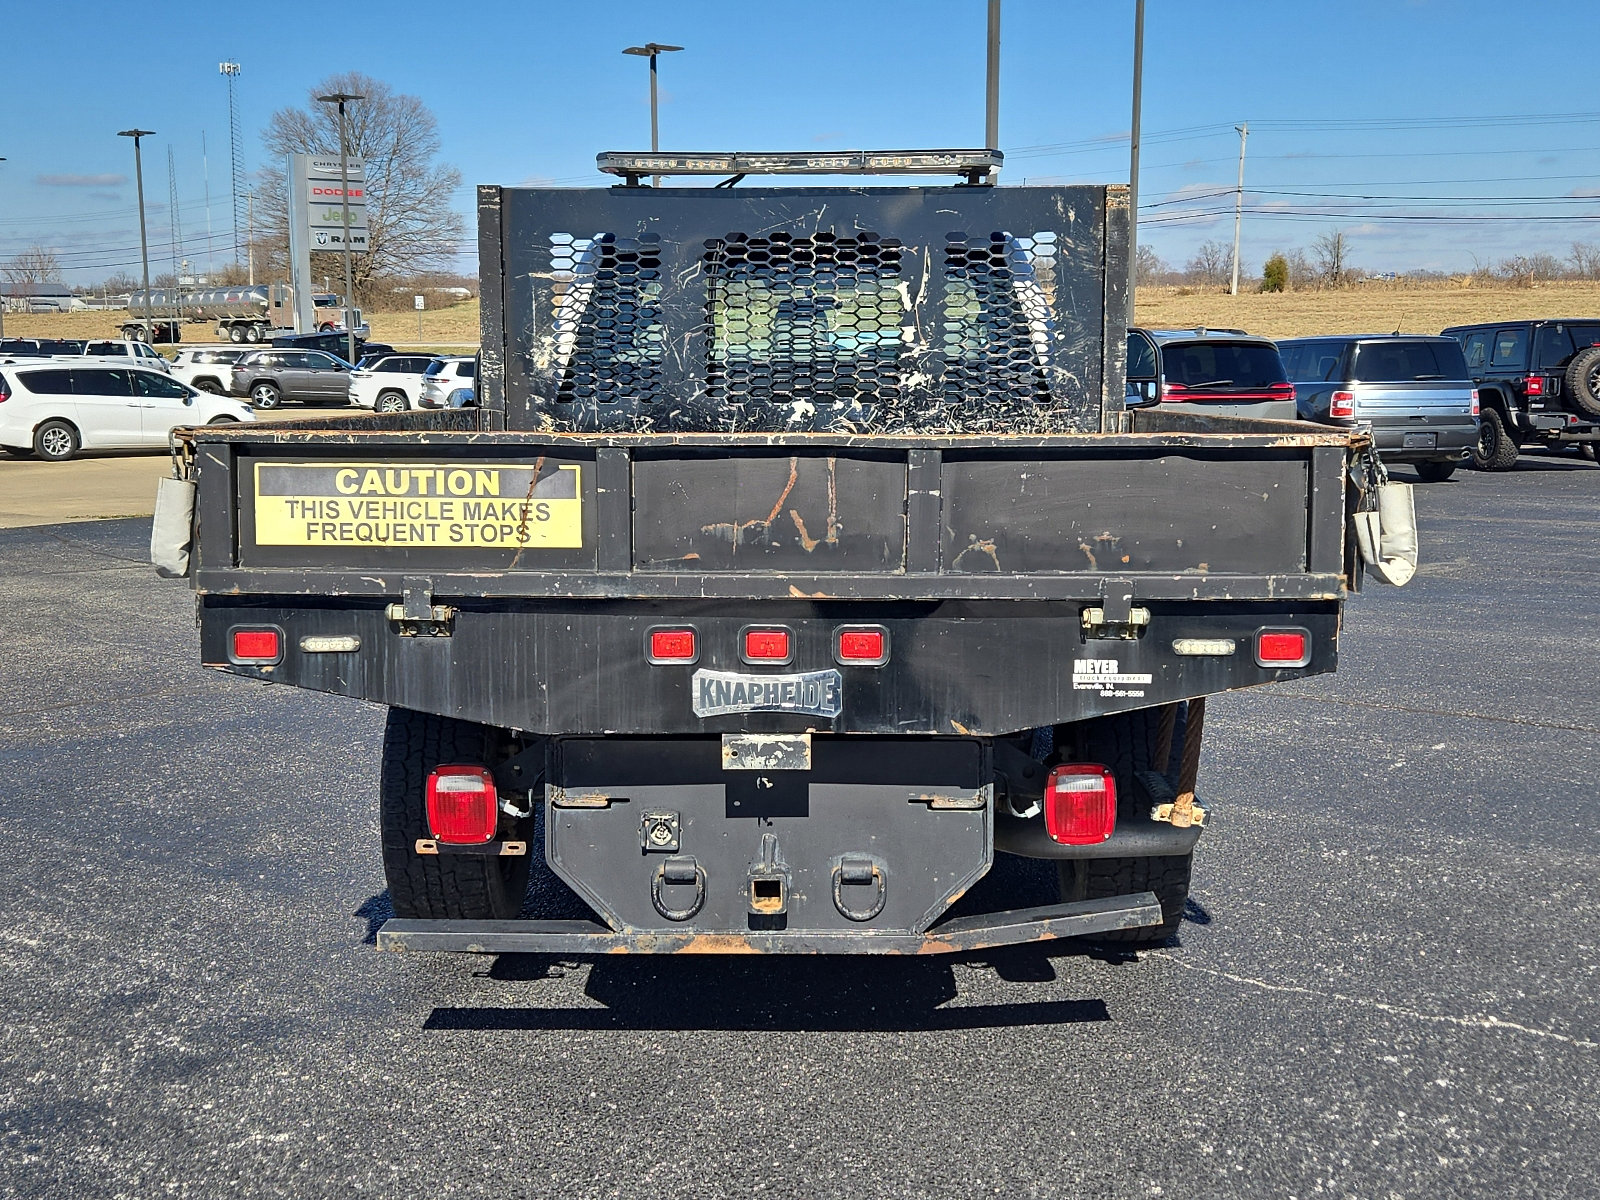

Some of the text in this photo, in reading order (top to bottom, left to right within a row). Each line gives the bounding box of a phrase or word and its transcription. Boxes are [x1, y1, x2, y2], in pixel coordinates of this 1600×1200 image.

[335, 469, 500, 495] CAUTION
[285, 499, 551, 521] THIS VEHICLE MAKES
[306, 522, 531, 543] FREQUENT STOPS
[1073, 659, 1119, 674] MEYER
[700, 677, 835, 711] KNAPHEIDE
